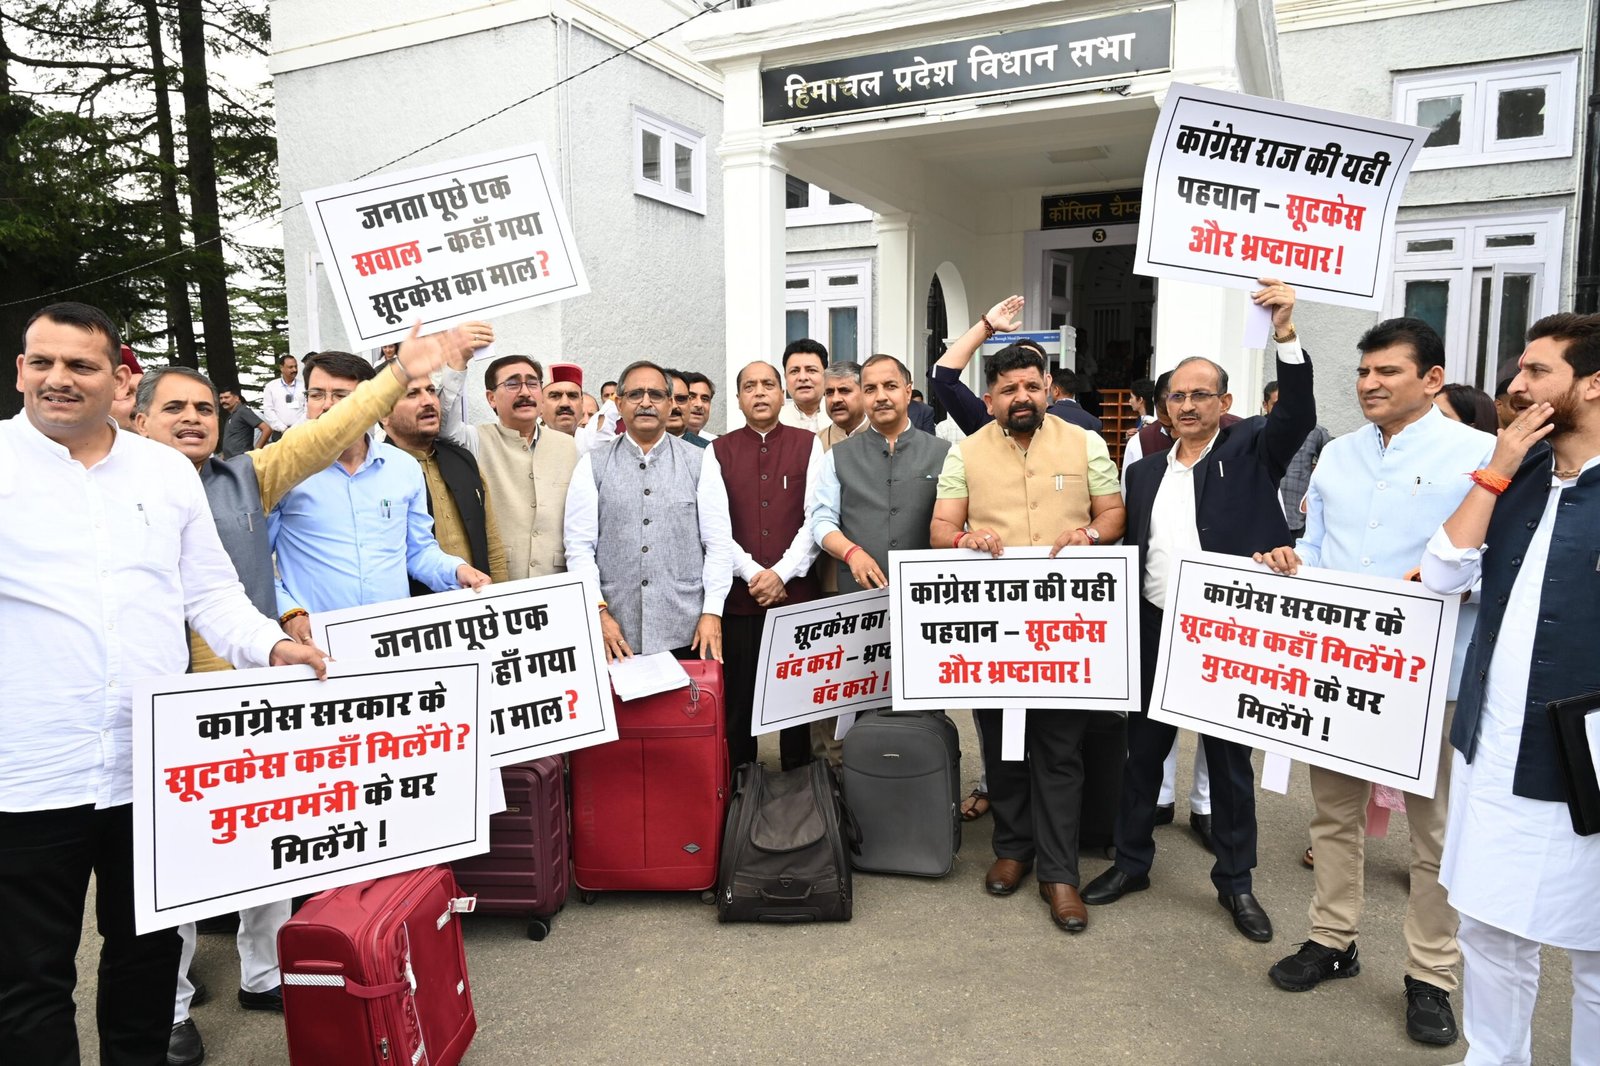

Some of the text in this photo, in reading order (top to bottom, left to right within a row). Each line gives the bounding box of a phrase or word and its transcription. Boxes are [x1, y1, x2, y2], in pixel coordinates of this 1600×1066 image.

[785, 32, 1135, 108] हिमाचल प्रदेश विधान सभा
[1176, 120, 1392, 186] कांग्रेस राज की यही
[356, 175, 511, 229] जनता पूछे एक
[1178, 176, 1260, 213] पहचान
[1287, 194, 1366, 232] सूटकेस
[352, 240, 422, 277] सवाल
[444, 216, 496, 254] कहाँ
[495, 212, 543, 240] गया
[1095, 230, 1104, 242] 3
[1189, 220, 1237, 257] और
[369, 276, 452, 324] सूटकेस
[452, 268, 487, 296] का
[910, 572, 1117, 604] कांग्रेस राज की यही
[1204, 581, 1405, 636] कांग्रेस सरकार के
[371, 604, 548, 657] जनता पूछे एक
[794, 609, 890, 650] सूटकेस का
[921, 621, 998, 644] पहचान
[1025, 613, 1107, 651] सूटकेस
[1180, 614, 1260, 647] सूटकेस
[1263, 631, 1317, 659] कहाँ
[492, 646, 576, 686] हाँ गया
[776, 654, 805, 680] बंद
[807, 645, 844, 673] करो
[813, 679, 841, 704] बंद
[842, 671, 879, 698] करो
[939, 654, 982, 683] और
[1202, 654, 1385, 715] मुख्यमंत्री के घर
[196, 681, 447, 740] कांग्रेस सरकार के
[1238, 694, 1313, 736] मिलेंगे
[164, 749, 289, 802] सूटकेस
[294, 734, 361, 773] कहाँ
[210, 773, 437, 844] मुख्यमंत्री के घर
[271, 821, 368, 870] मिलेंगे
